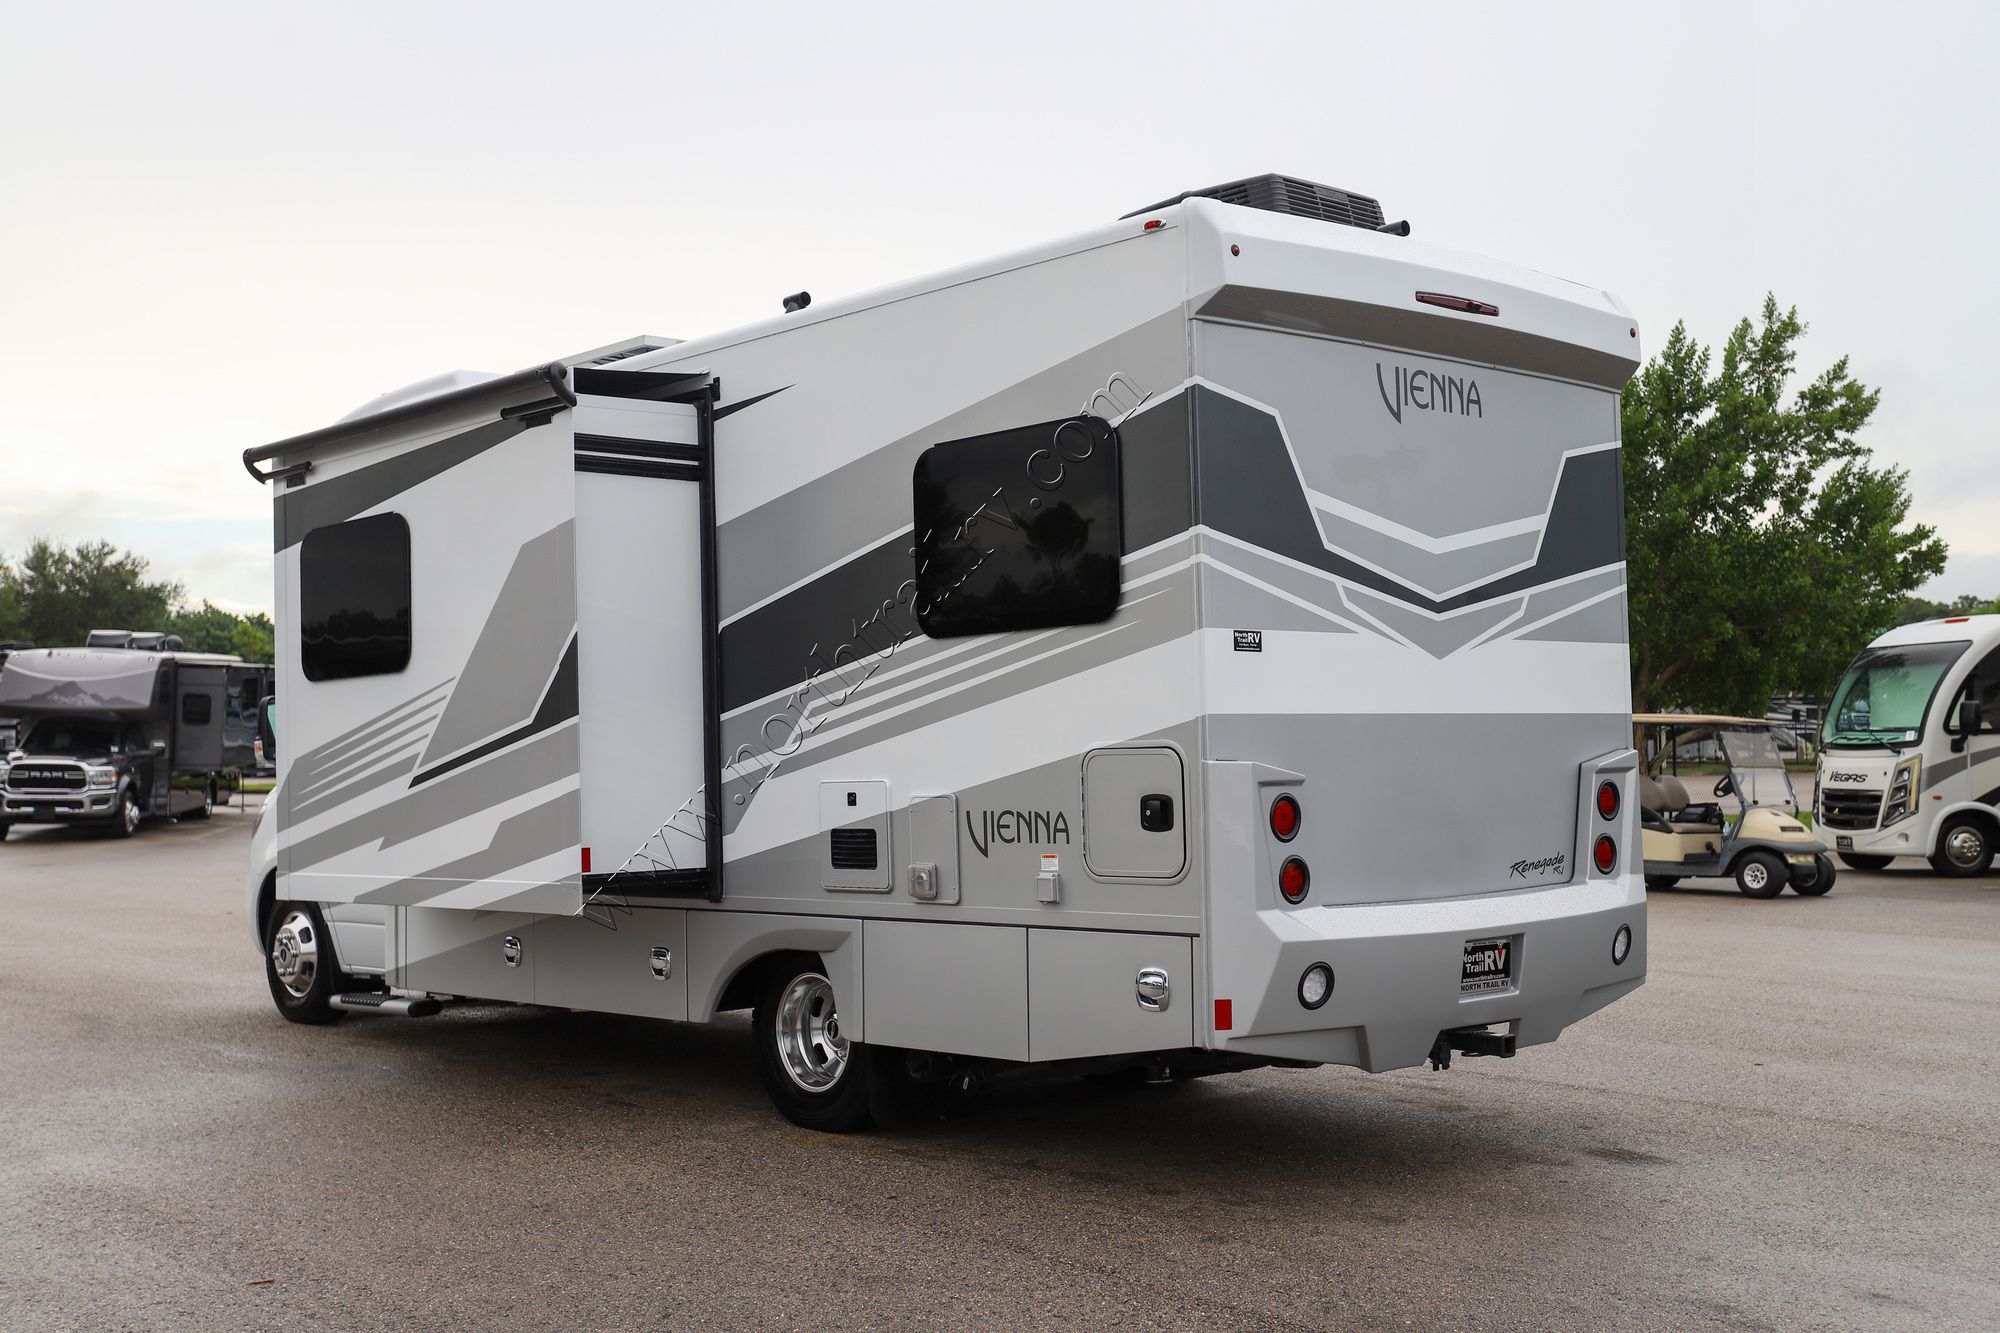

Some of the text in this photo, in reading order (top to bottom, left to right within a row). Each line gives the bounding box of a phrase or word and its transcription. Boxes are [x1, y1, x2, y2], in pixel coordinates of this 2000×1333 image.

[1376, 363, 1482, 424] VIENNA
[1248, 633, 1260, 643] RV
[30, 770, 62, 778] RAM
[965, 809, 1070, 859] VIENNA
[1510, 851, 1564, 879] Renegade
[1552, 865, 1565, 875] RV
[1463, 952, 1484, 963] North
[1484, 949, 1506, 971] RV
[1465, 962, 1484, 973] Trail
[1460, 983, 1481, 992] NORTH
[1482, 980, 1500, 989] TRAIL
